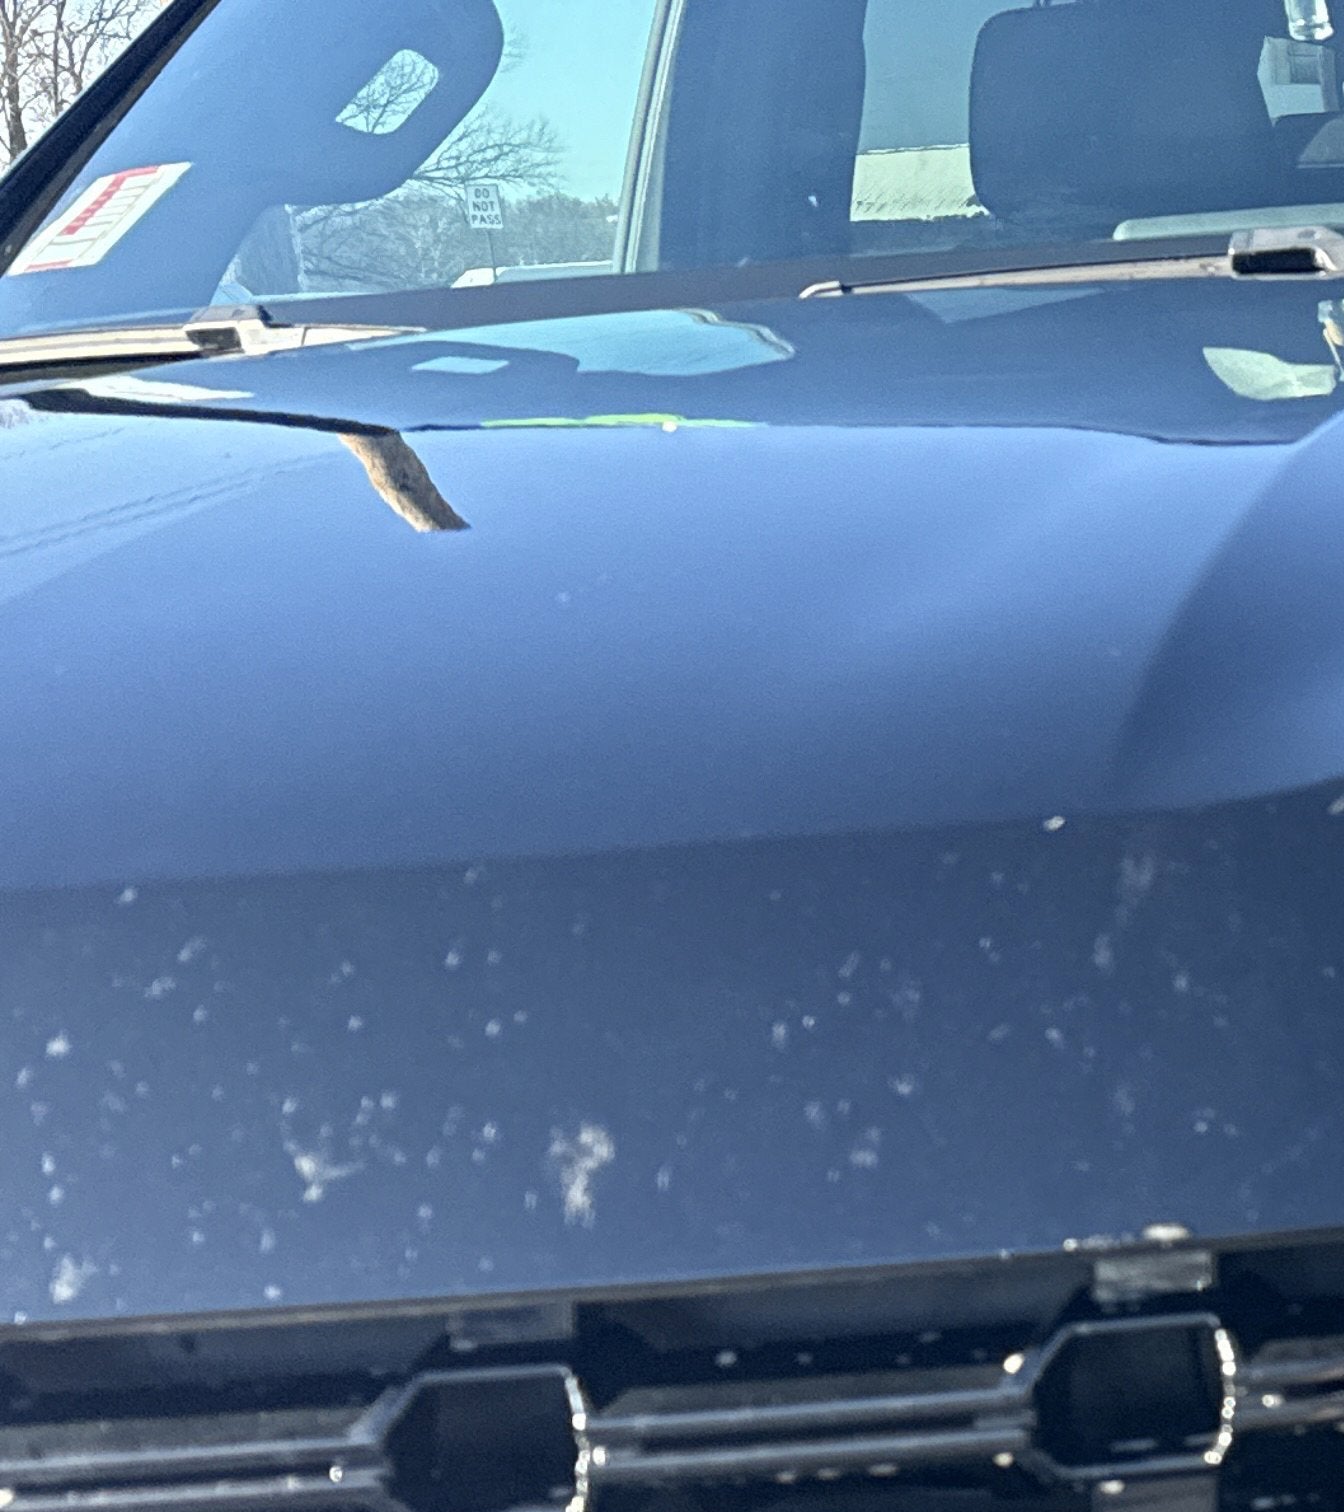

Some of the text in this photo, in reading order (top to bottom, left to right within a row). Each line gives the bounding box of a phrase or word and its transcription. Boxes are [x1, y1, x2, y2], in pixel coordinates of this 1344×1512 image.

[474, 187, 490, 199] DO
[472, 200, 495, 211] NOT
[471, 214, 501, 225] PASS
